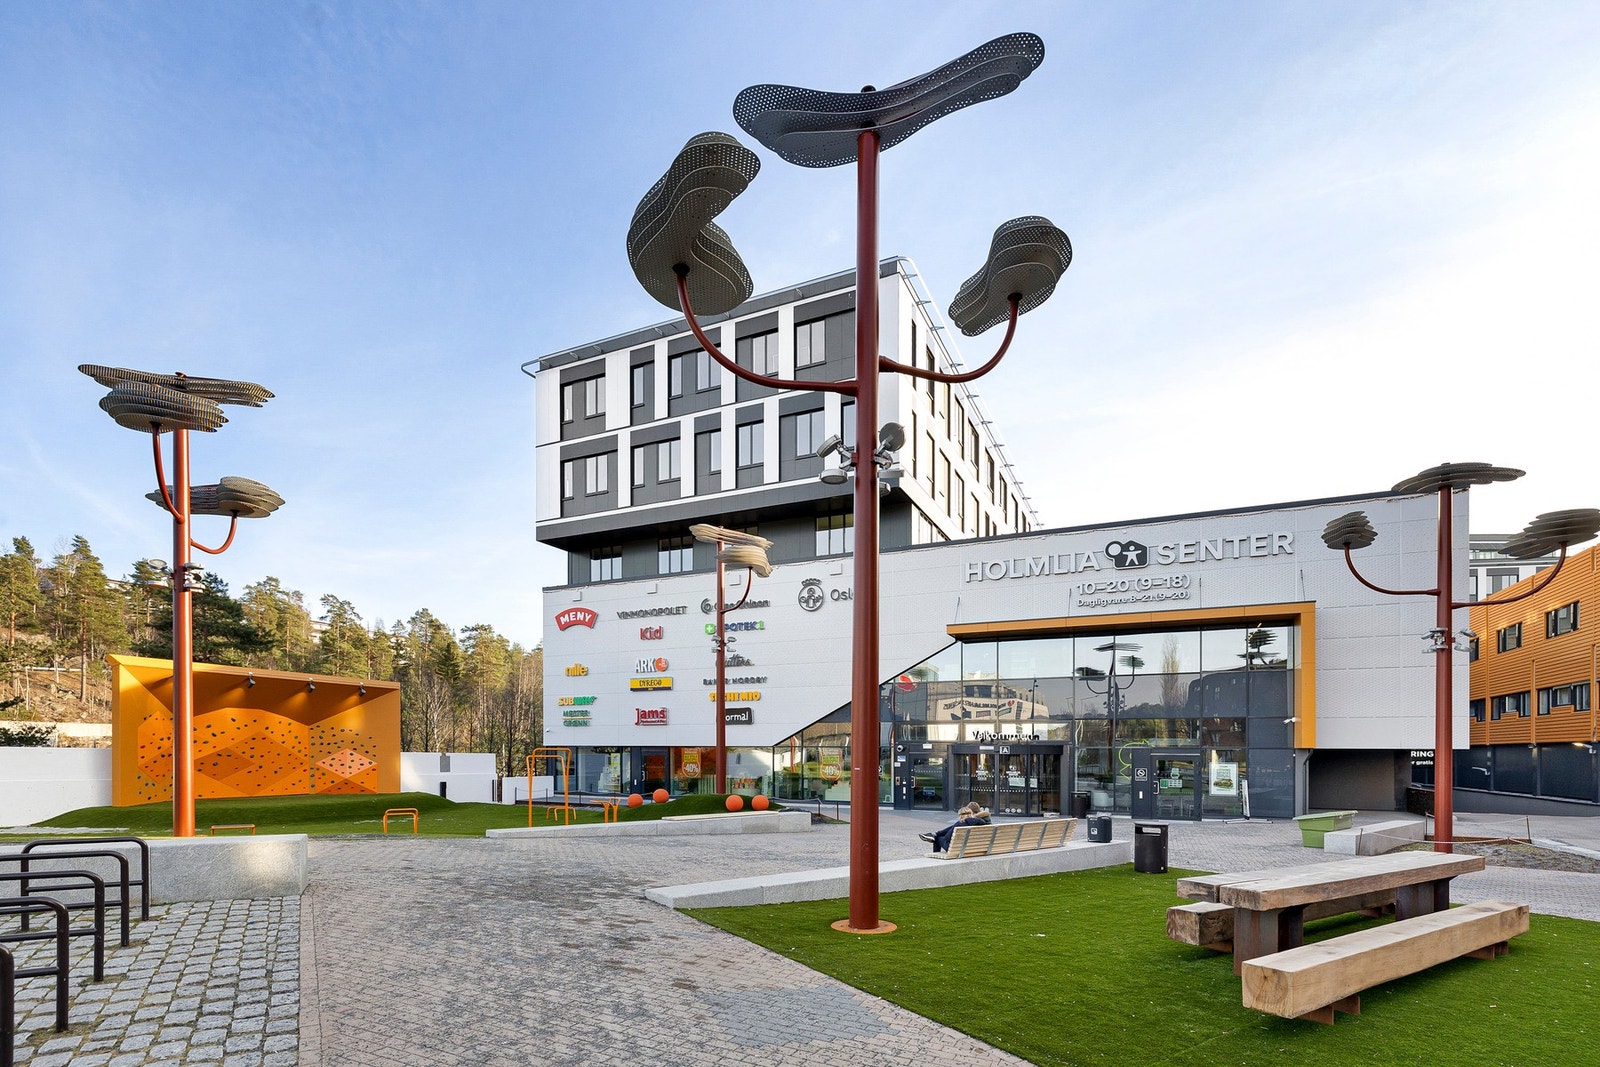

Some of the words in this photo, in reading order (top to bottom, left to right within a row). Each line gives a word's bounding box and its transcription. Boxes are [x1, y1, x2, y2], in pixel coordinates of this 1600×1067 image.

[965, 551, 1100, 582] HOLMLIA
[1157, 531, 1294, 565] SENTER
[831, 588, 853, 601] Osl
[560, 611, 592, 624] MENY
[617, 606, 687, 620] VINMONOPOLET
[640, 626, 662, 640] Kid
[635, 660, 655, 673] ARK
[558, 696, 596, 706] SUBWAY
[725, 711, 749, 721] ormal
